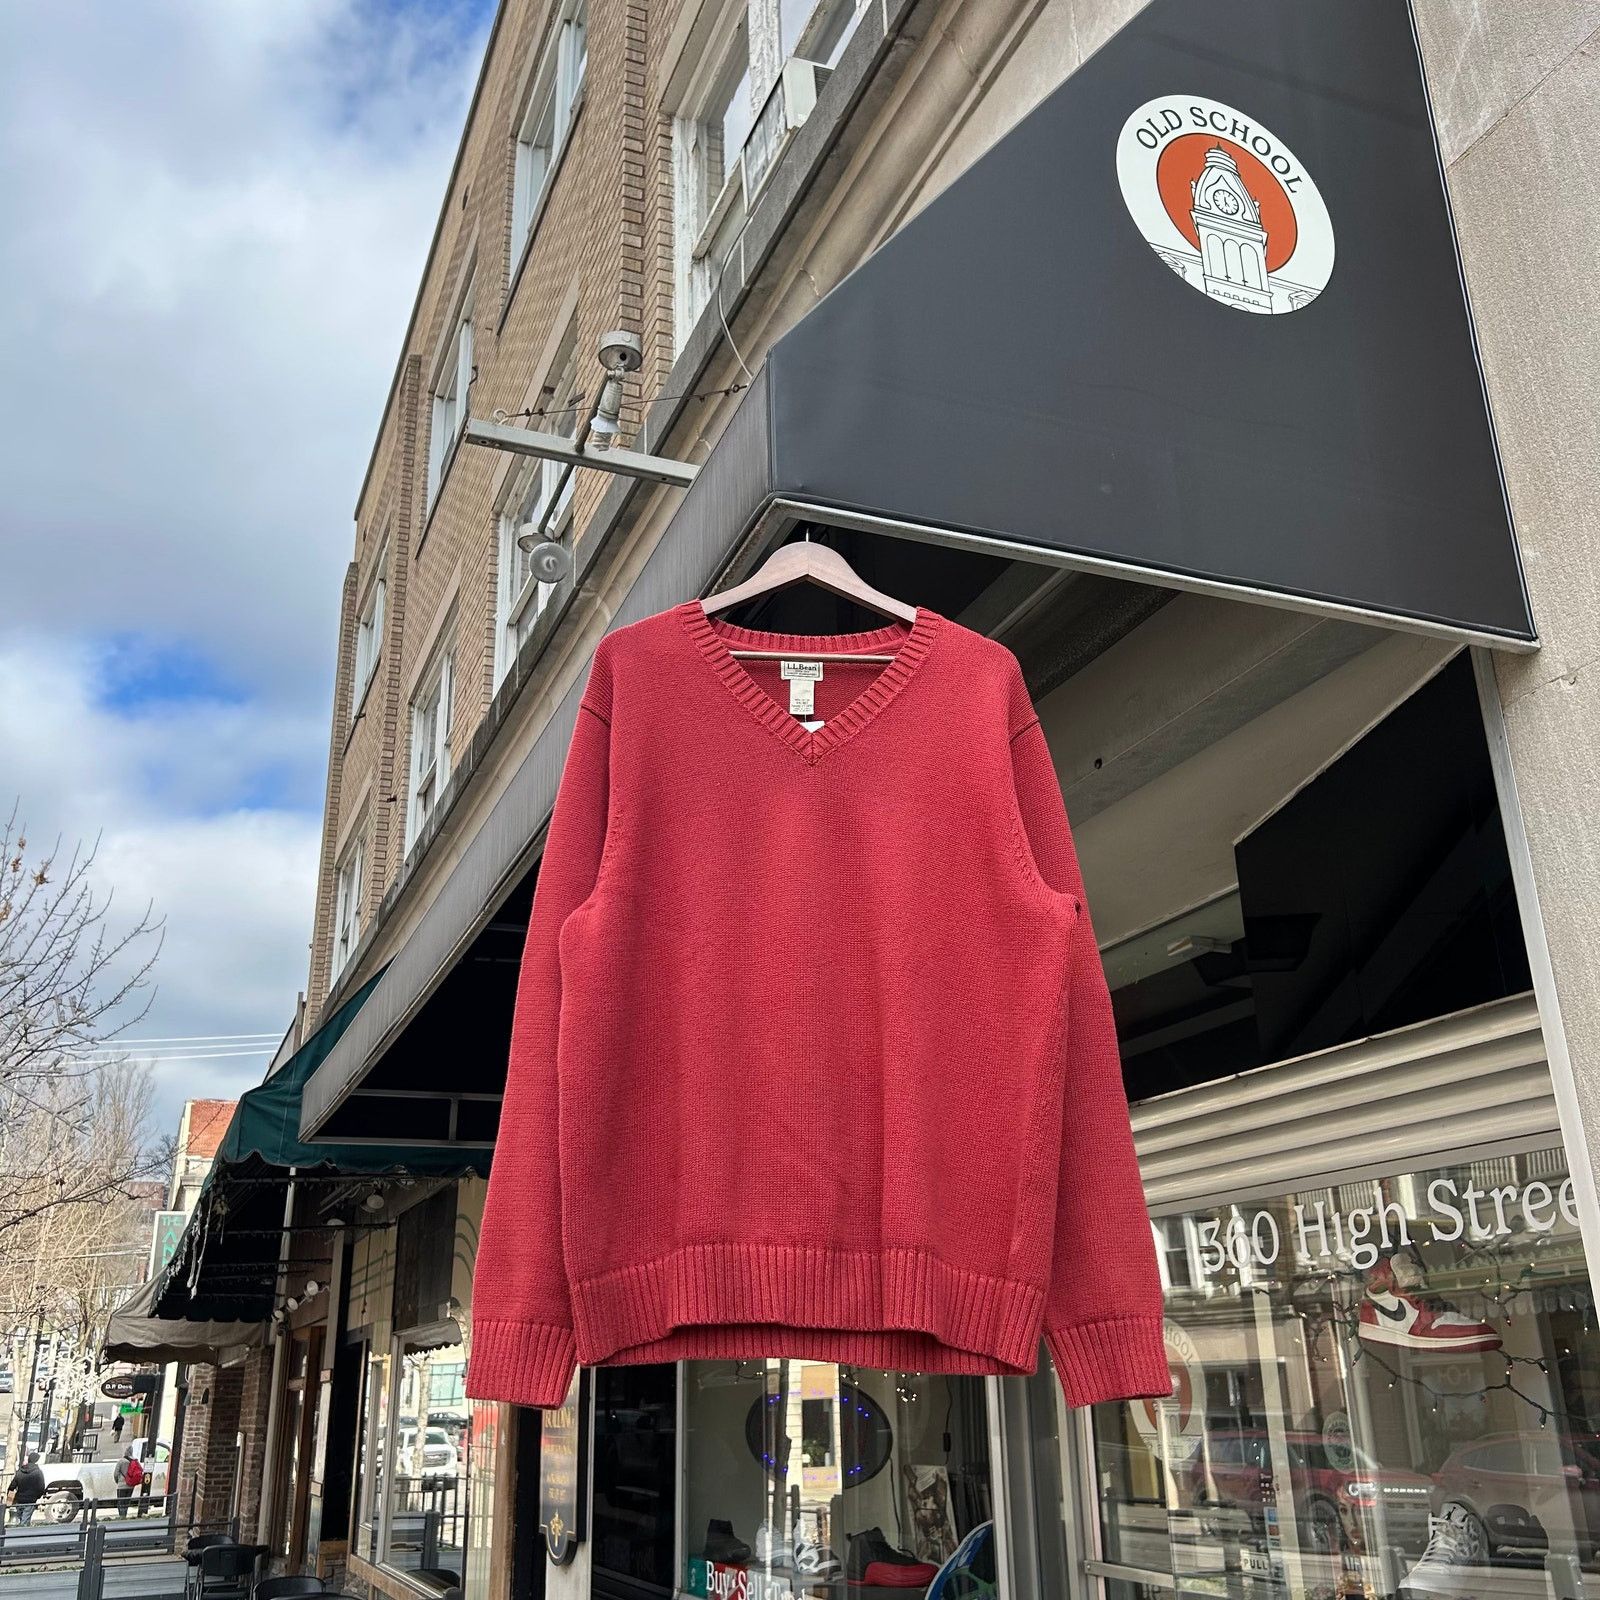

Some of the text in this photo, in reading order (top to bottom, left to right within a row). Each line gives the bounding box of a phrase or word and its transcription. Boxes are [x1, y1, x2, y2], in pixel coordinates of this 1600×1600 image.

[1136, 106, 1303, 194] OLD SCHOOL
[1198, 1178, 1580, 1272] 360 High Stree
[1165, 1325, 1193, 1368] HOOL
[706, 1560, 730, 1600] Buy
[738, 1570, 763, 1600] Sell
[1243, 1558, 1268, 1570] PULL
